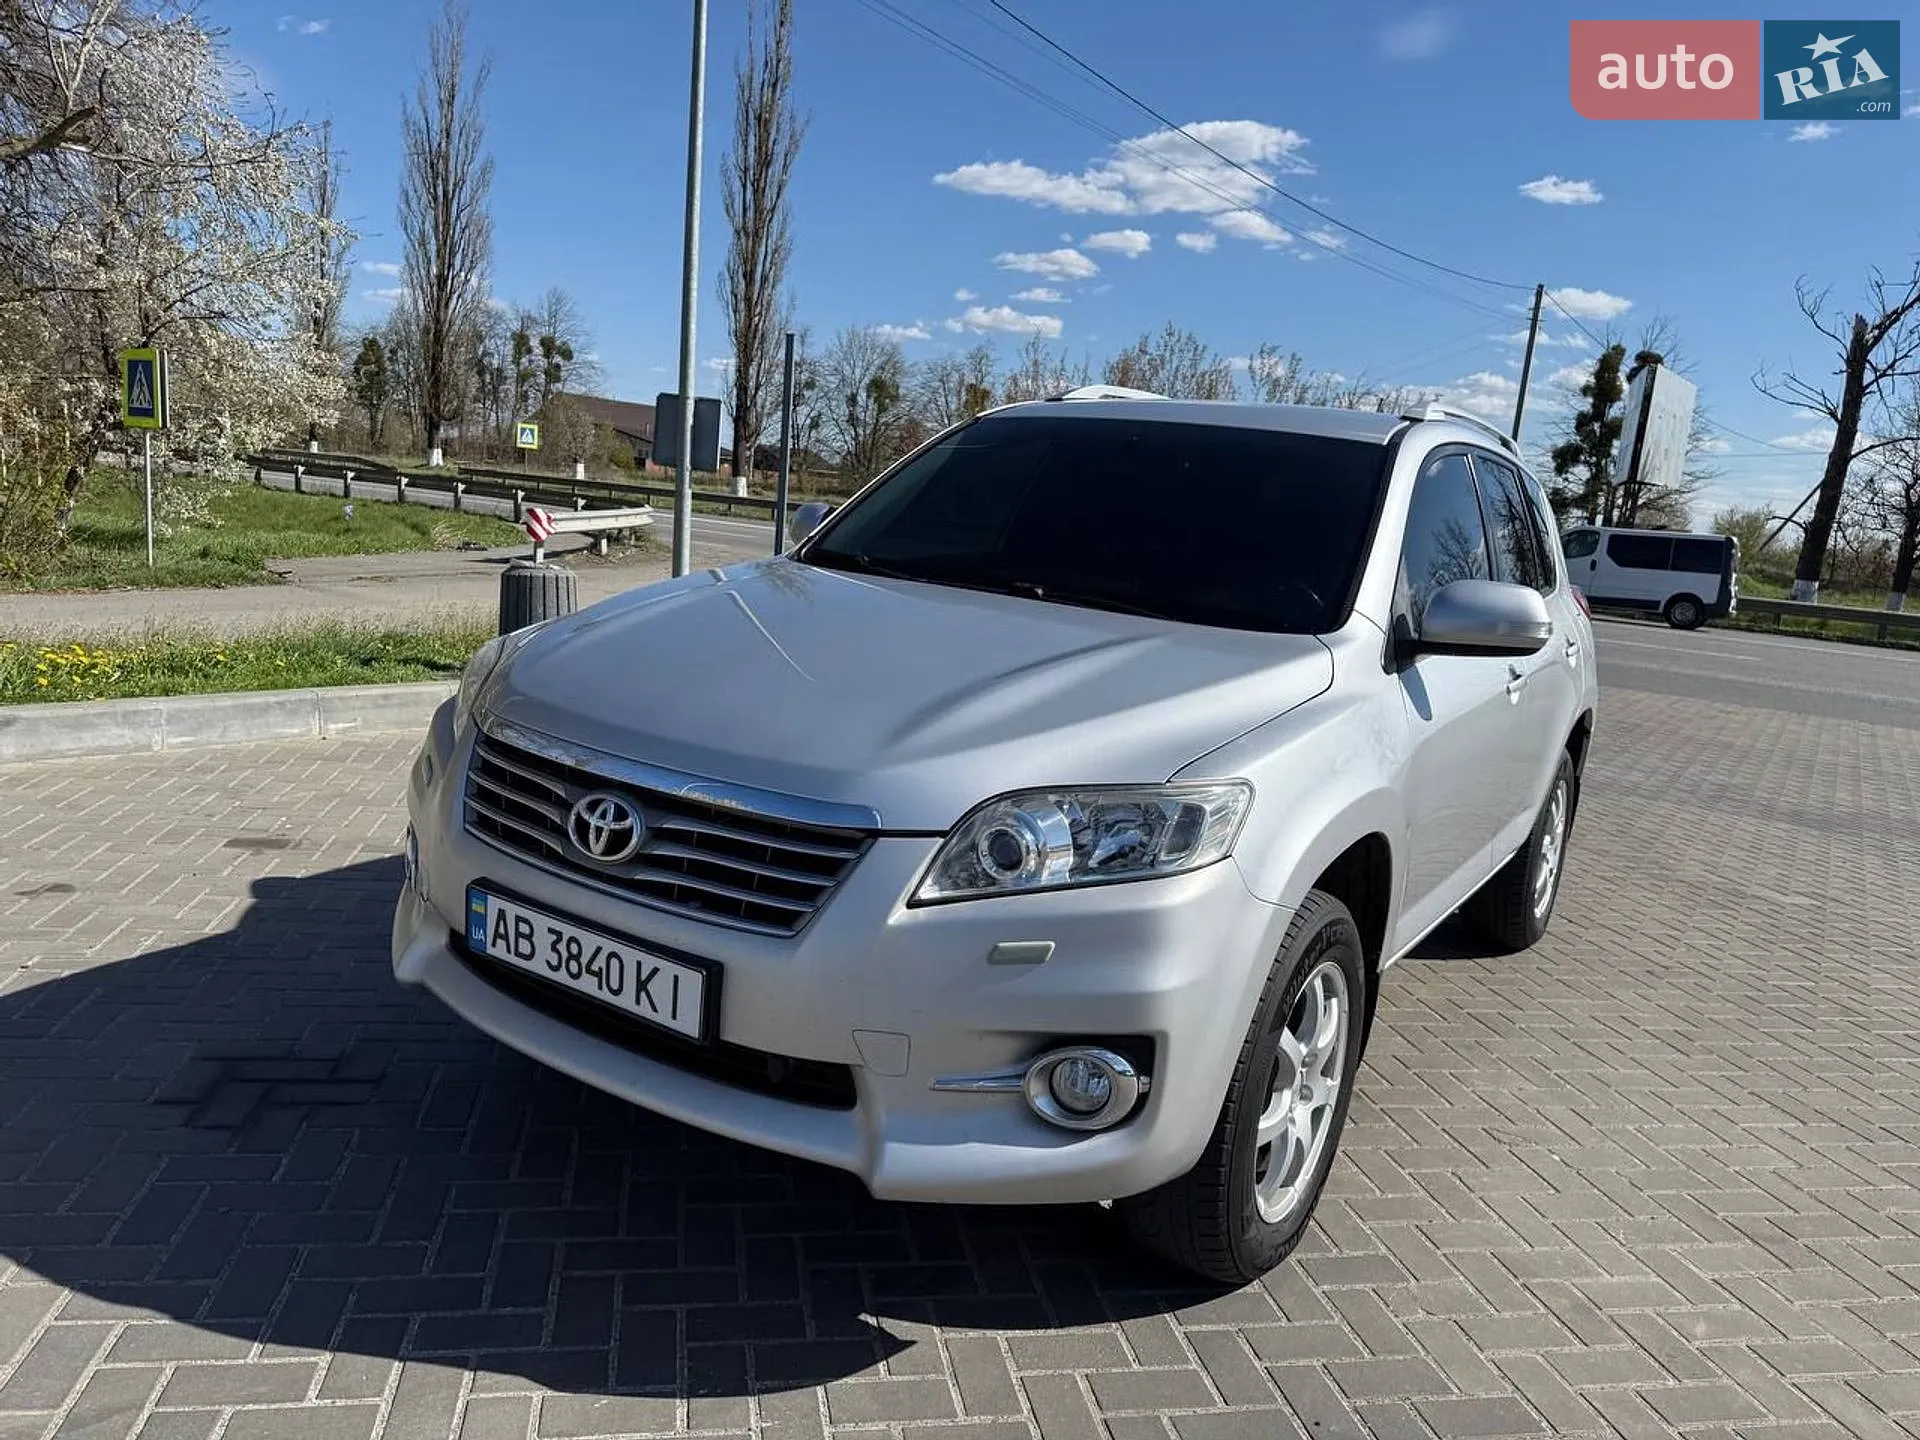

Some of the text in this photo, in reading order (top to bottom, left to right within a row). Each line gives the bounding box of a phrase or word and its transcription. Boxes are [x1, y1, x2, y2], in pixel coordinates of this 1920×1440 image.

[472, 926, 485, 942] UA
[491, 908, 679, 1020] AB 3840 KI
